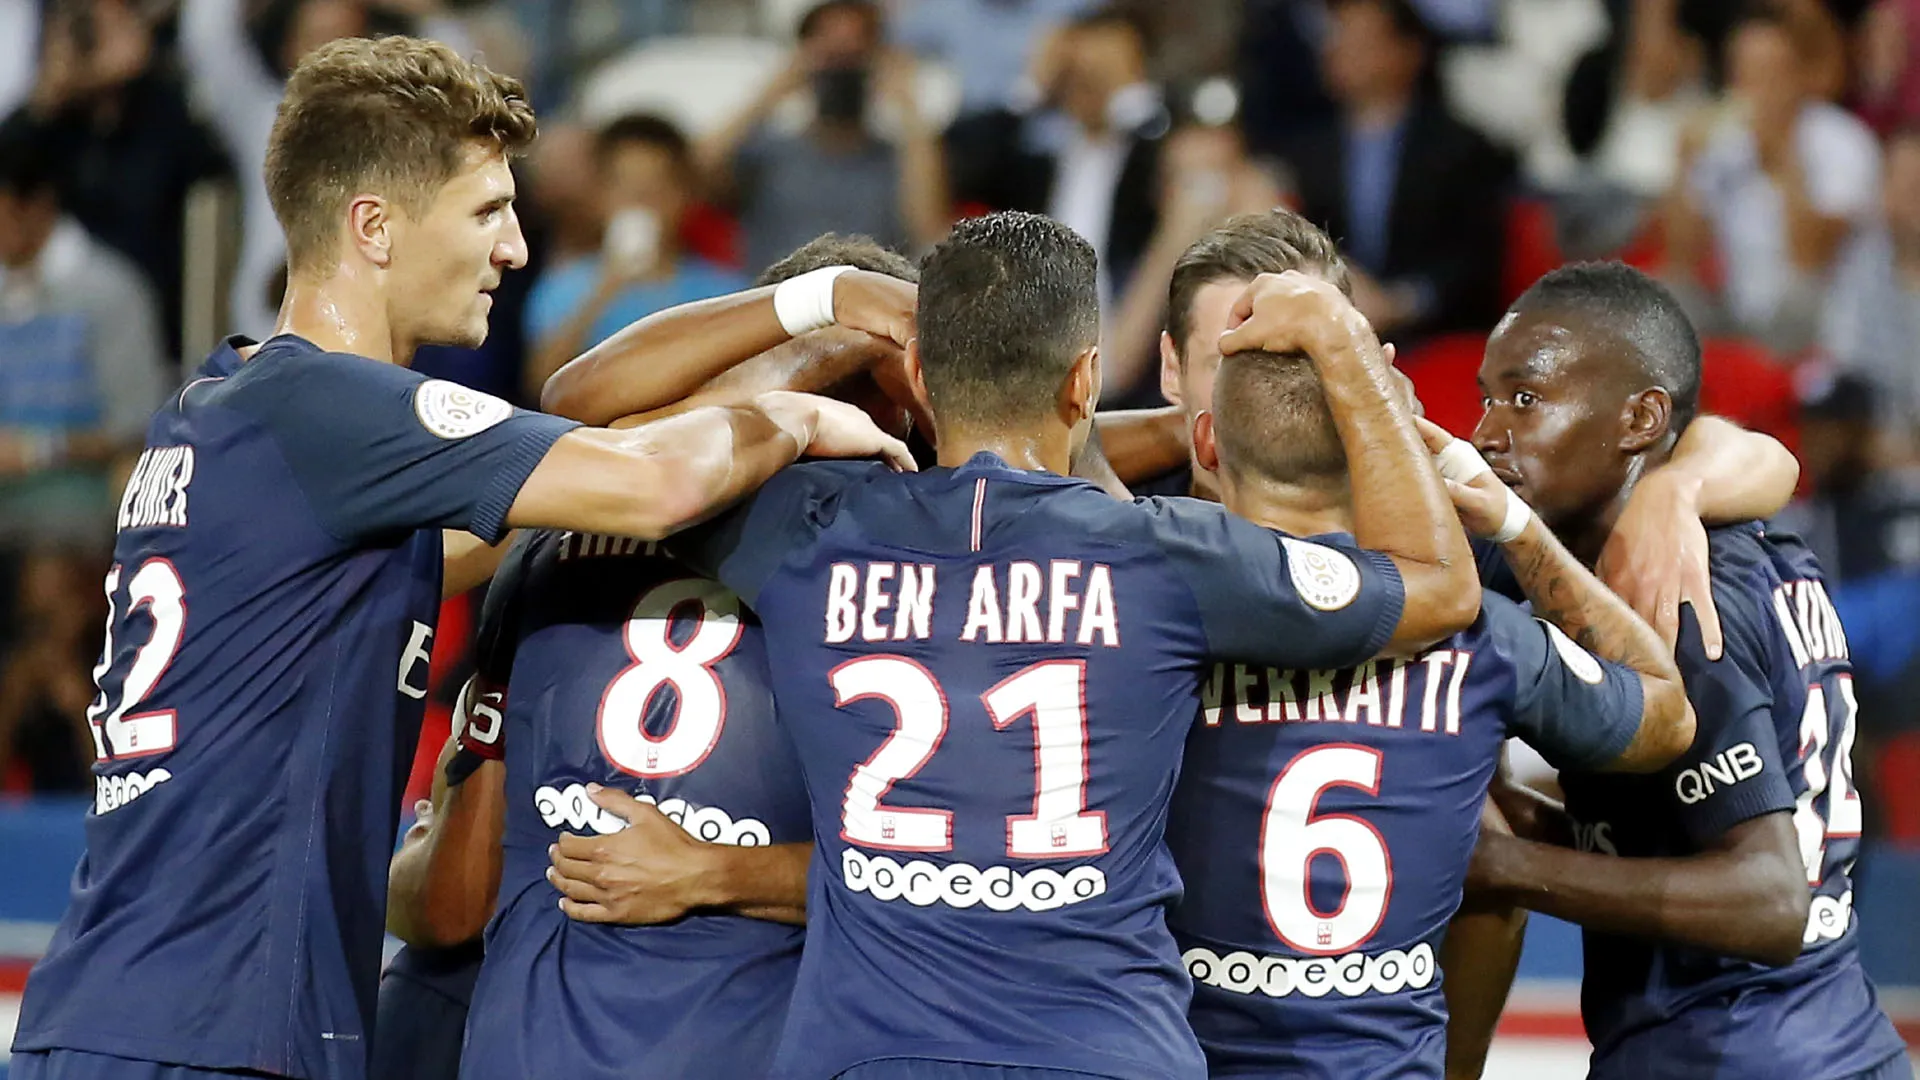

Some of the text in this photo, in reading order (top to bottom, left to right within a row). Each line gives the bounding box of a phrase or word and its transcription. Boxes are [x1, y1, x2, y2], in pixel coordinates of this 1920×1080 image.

[825, 560, 1121, 647] BEN ARFA
[596, 577, 745, 778] 8
[827, 653, 1110, 858] 21
[1676, 742, 1763, 805] QNB
[844, 850, 1105, 908] ooredoo
[1258, 743, 1393, 956] 6
[1184, 945, 1435, 995] ooredoo
